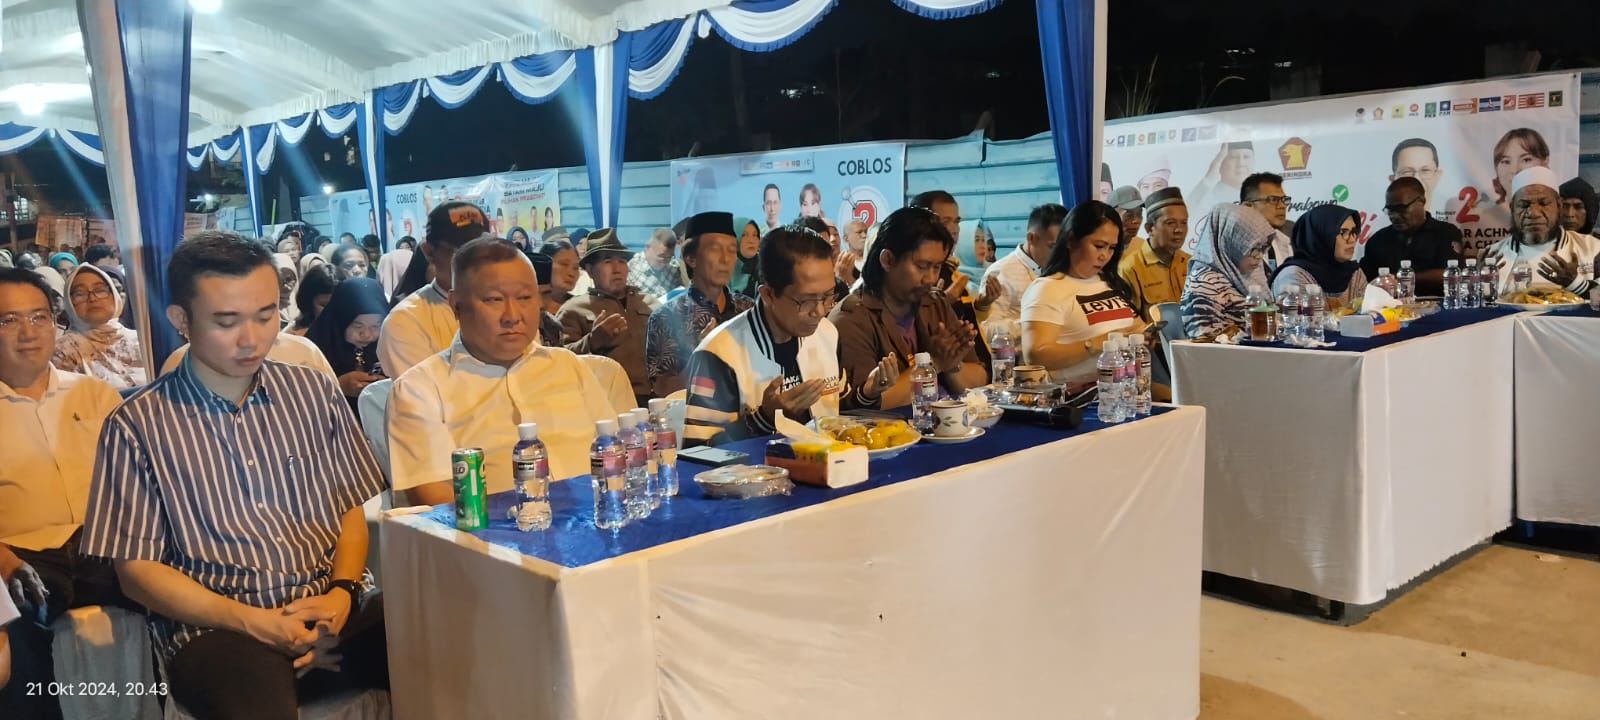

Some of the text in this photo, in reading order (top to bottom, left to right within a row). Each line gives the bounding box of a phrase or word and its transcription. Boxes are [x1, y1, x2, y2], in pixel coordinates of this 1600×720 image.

[838, 157, 892, 176] COBLOS
[852, 199, 877, 229] 2
[1456, 186, 1480, 223] 2
[1475, 228, 1512, 238] ACHM
